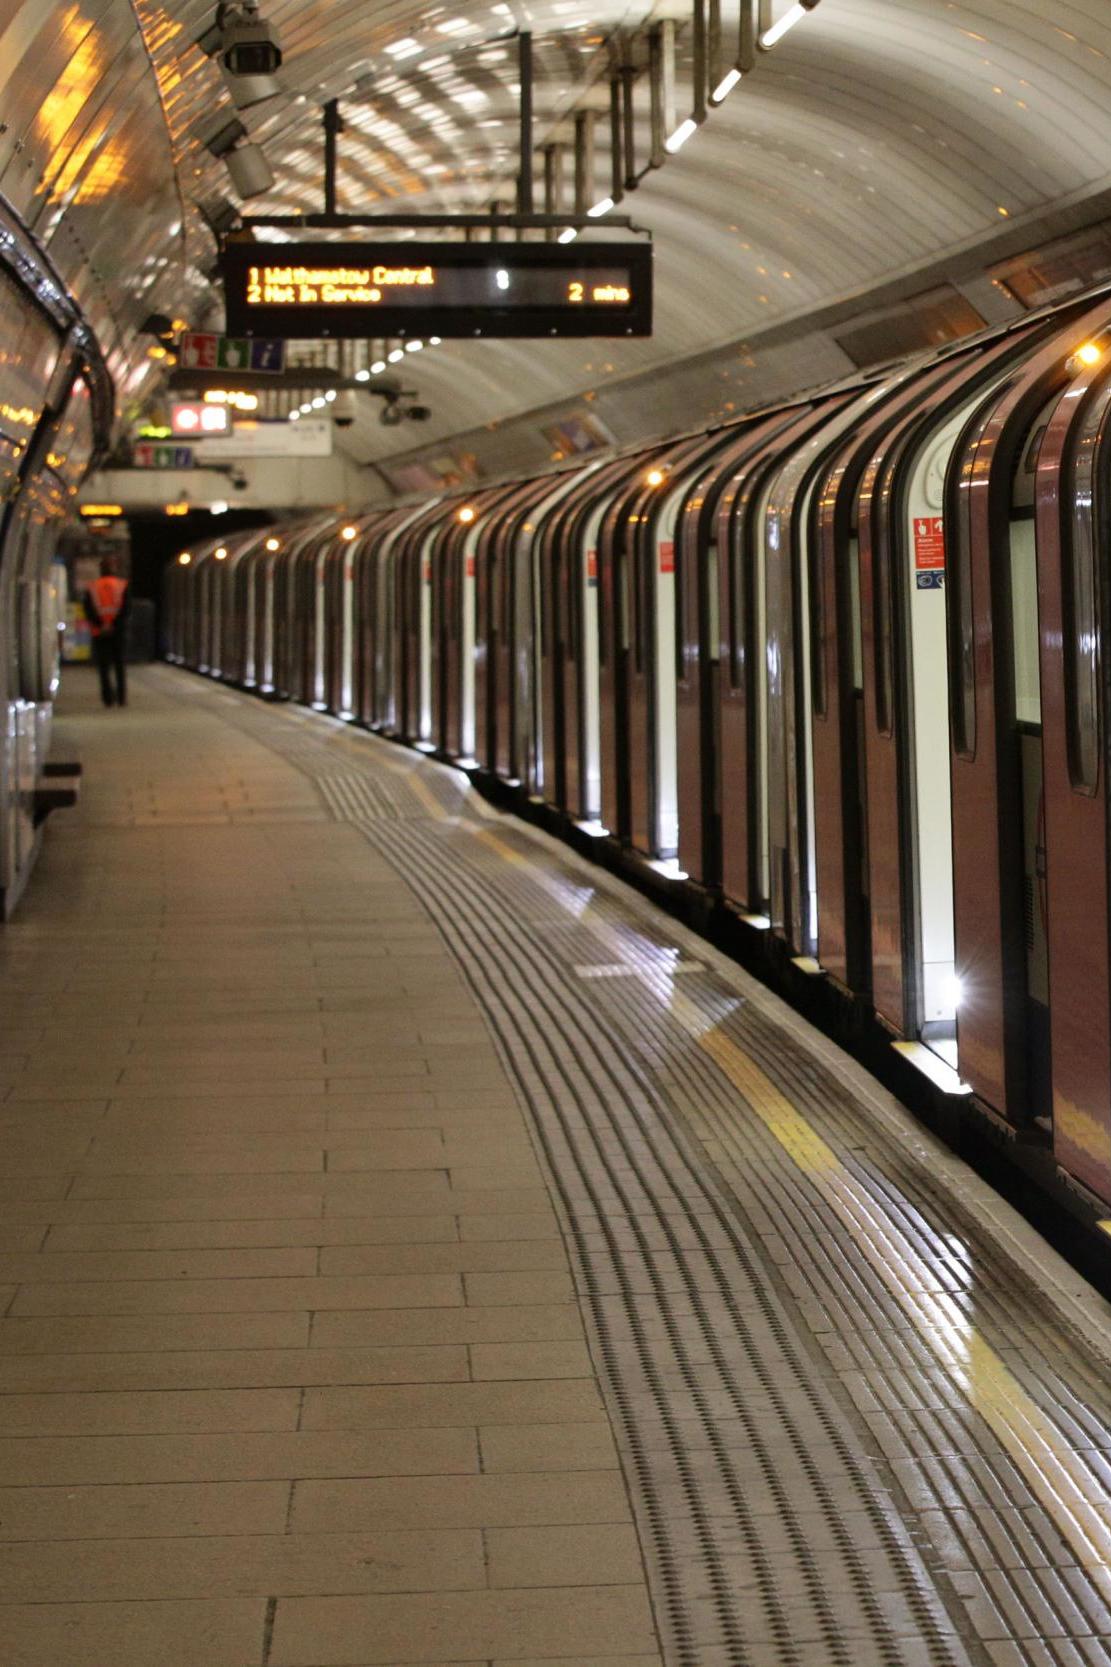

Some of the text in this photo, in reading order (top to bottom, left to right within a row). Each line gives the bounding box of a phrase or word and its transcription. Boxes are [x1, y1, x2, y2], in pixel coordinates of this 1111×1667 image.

[249, 266, 434, 285] 1 Walthamstow Central
[247, 284, 261, 302] 2
[264, 284, 295, 302] Not
[320, 284, 381, 302] Service
[569, 282, 583, 301] 2
[593, 285, 630, 301] mins
